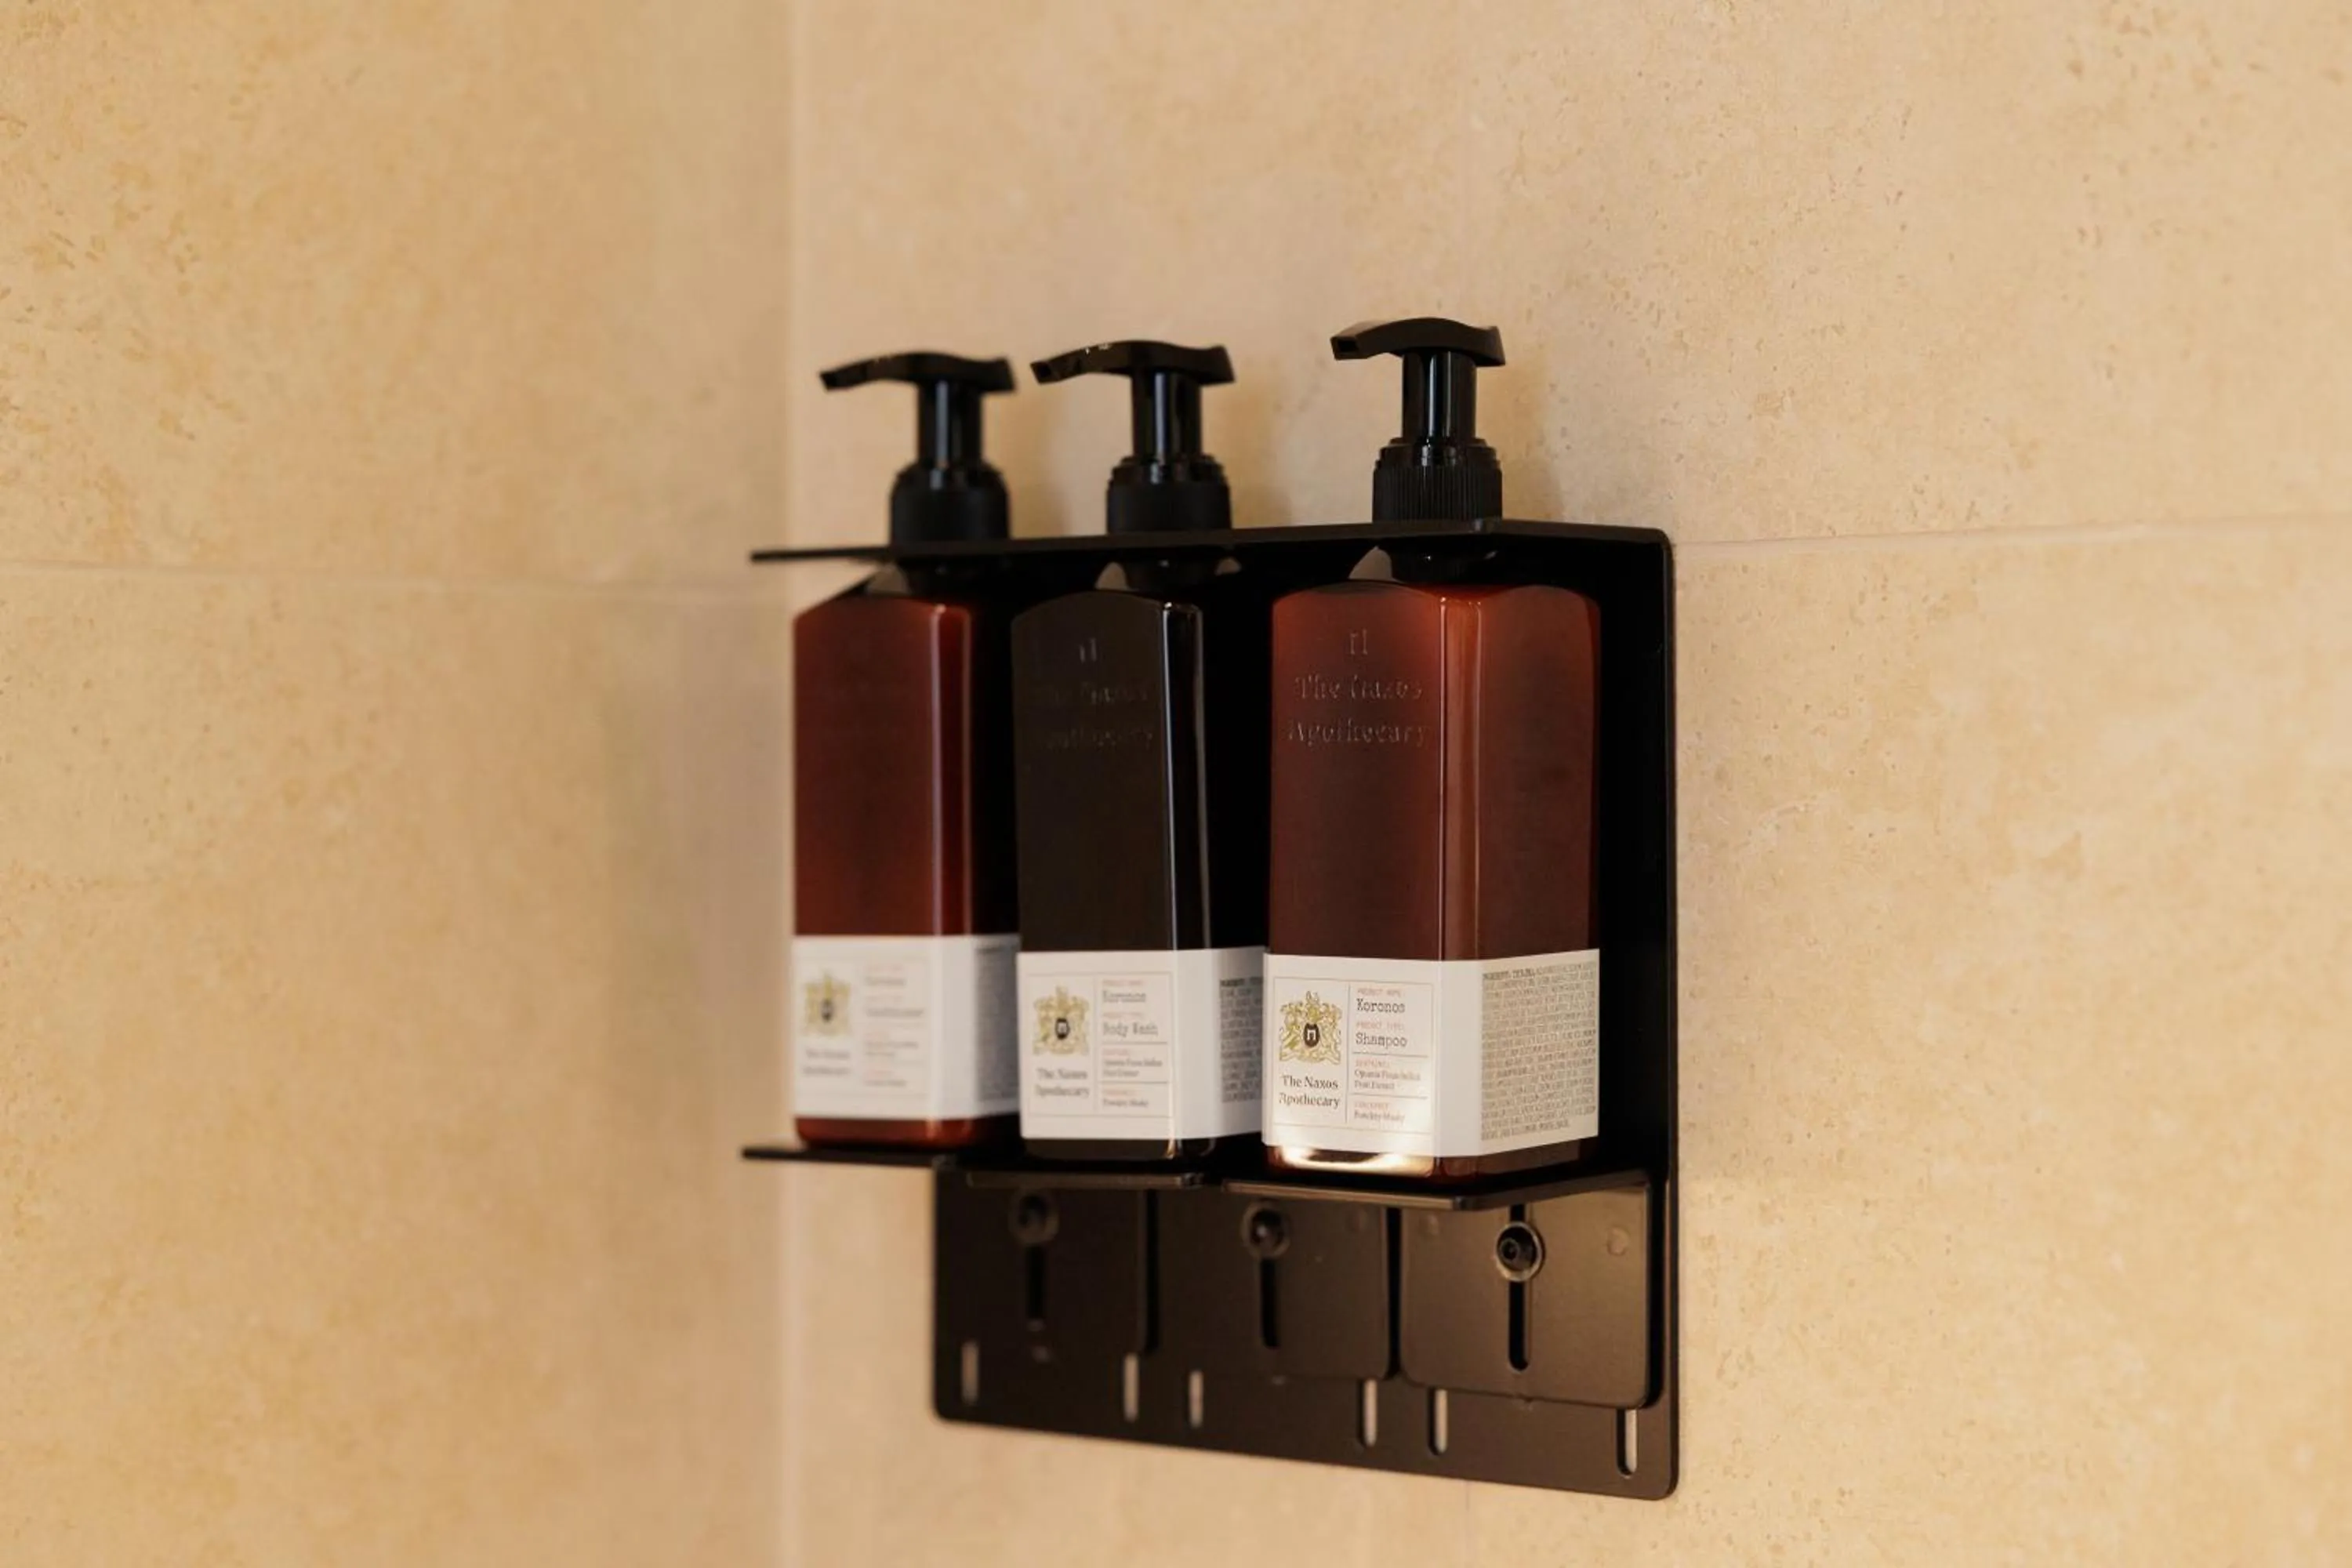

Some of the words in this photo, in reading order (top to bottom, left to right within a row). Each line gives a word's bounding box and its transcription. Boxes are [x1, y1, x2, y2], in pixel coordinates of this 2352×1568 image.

[1356, 998, 1406, 1014] Koronos
[1355, 1032, 1408, 1049] Shampoo
[1280, 1075, 1303, 1088] The
[1304, 1075, 1339, 1090] Naxos
[1279, 1092, 1341, 1109] Apothecary
